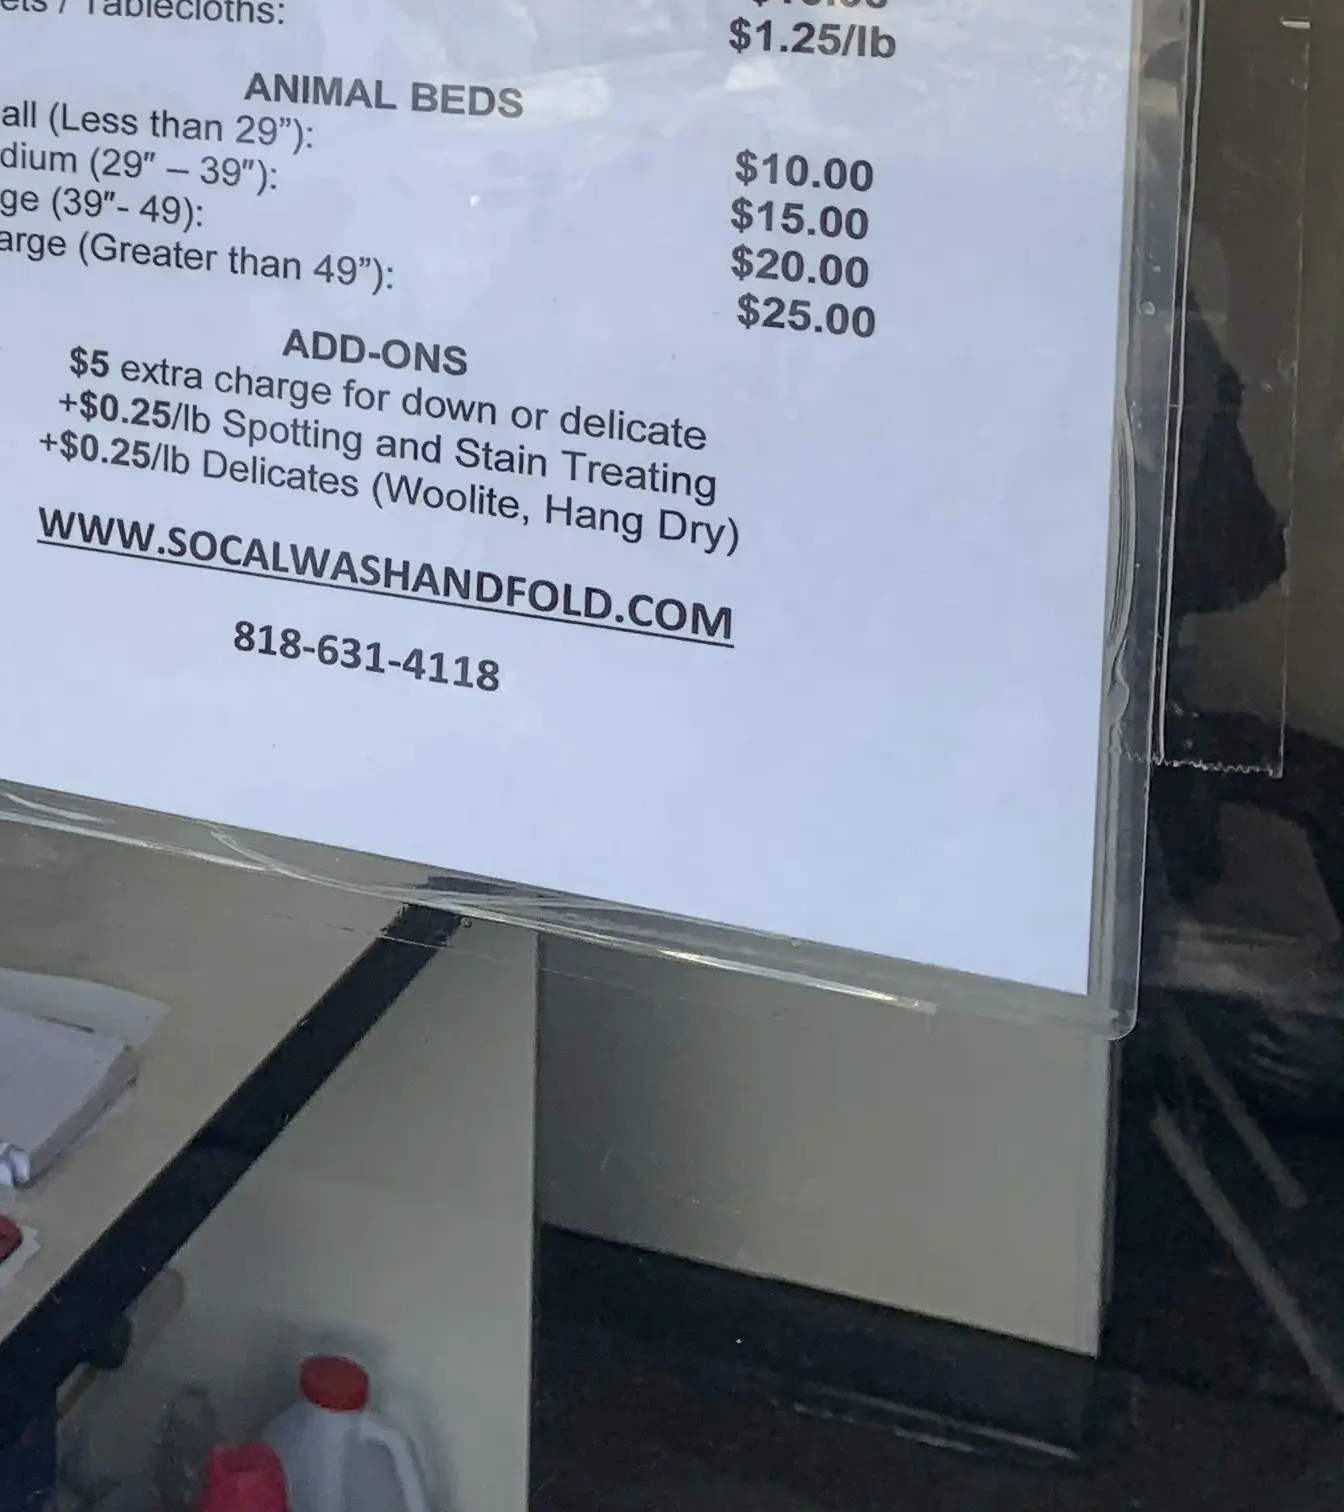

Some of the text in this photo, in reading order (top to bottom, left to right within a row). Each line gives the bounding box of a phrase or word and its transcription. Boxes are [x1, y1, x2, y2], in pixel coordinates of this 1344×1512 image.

[243, 71, 524, 119] ANIMAL BEDS
[48, 101, 139, 138] (Less
[149, 108, 223, 142] than
[734, 148, 874, 193] $10.00
[730, 195, 869, 241] $15.00
[78, 230, 219, 272] (Greater
[227, 245, 302, 281] than
[730, 243, 870, 289] $20.00
[736, 291, 876, 339] $25.00
[281, 328, 468, 377] ADD-ONS
[69, 345, 707, 451] $5 extra charge for down or delicate
[58, 388, 717, 507] +$0.25/lb Spotting and Stain Treating
[38, 428, 740, 558] +$0.25/lb Delicates (Woolite, Hang Dry)
[37, 506, 733, 641] WWW.SOCALWASHANDFOLD.COM
[233, 620, 500, 692] 818-631-4118
